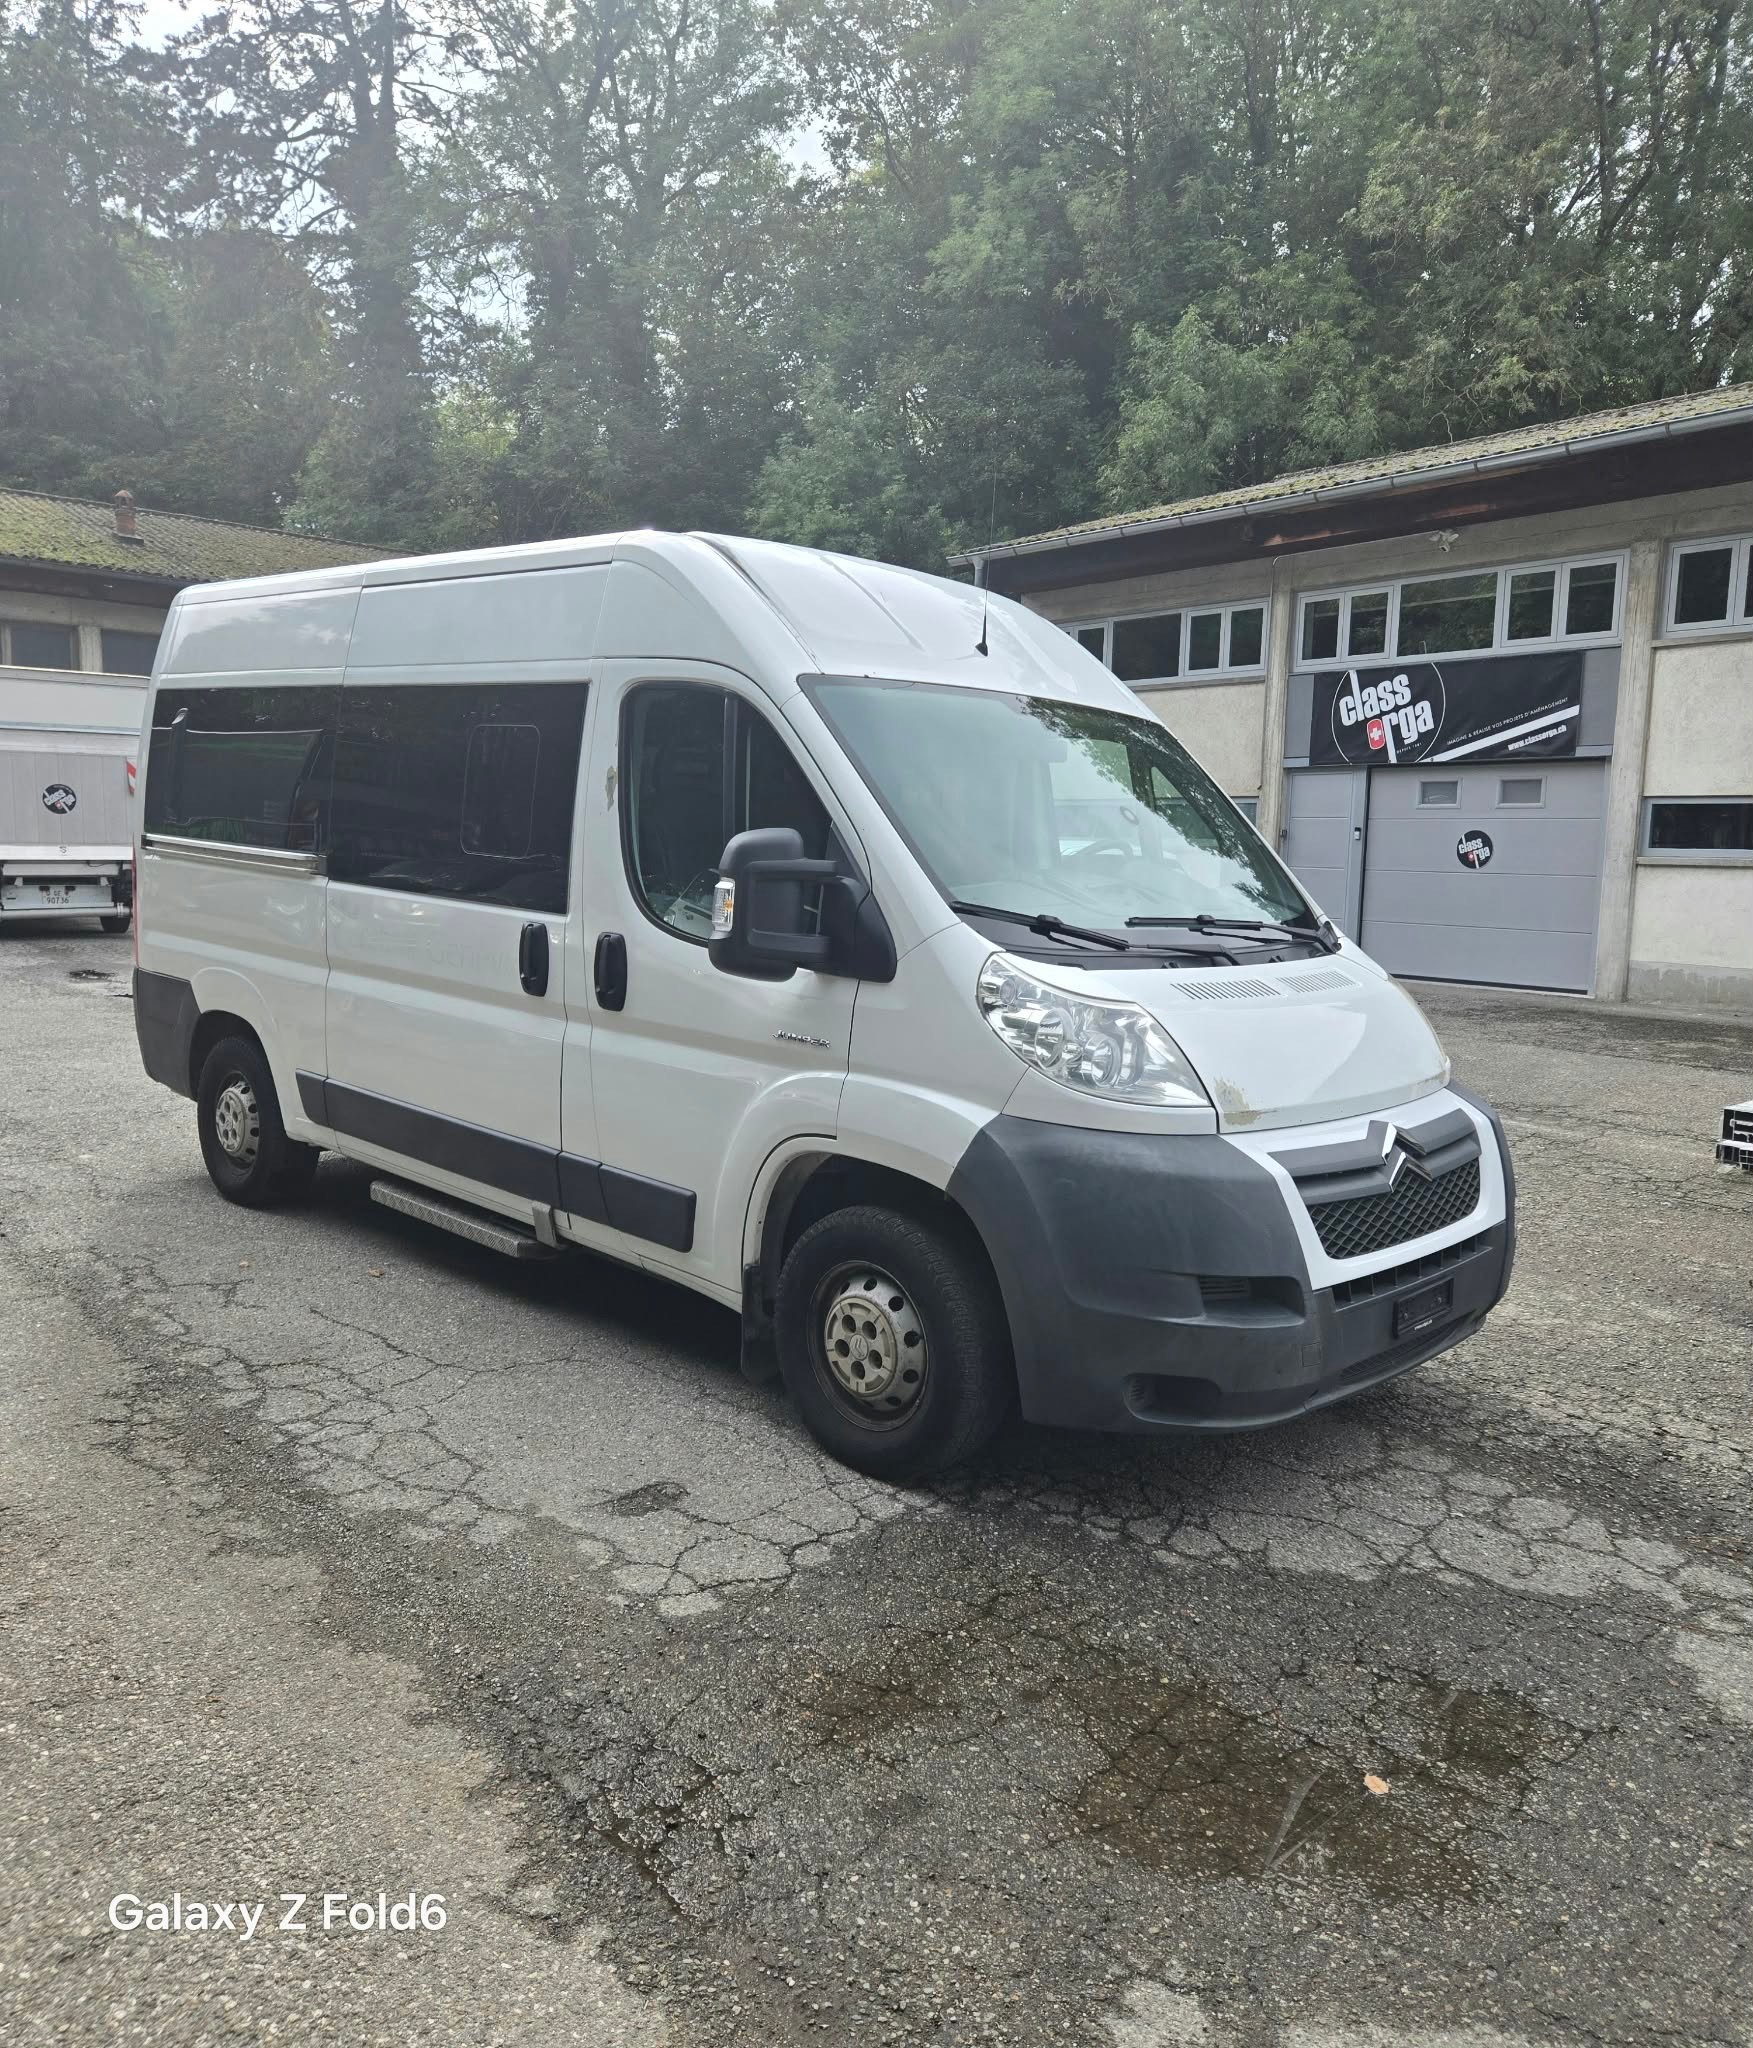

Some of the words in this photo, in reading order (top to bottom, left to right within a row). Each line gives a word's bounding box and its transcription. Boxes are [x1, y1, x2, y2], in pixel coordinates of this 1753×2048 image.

[1339, 669, 1412, 727] class
[1492, 721, 1503, 729] VOS
[1458, 833, 1483, 854] class
